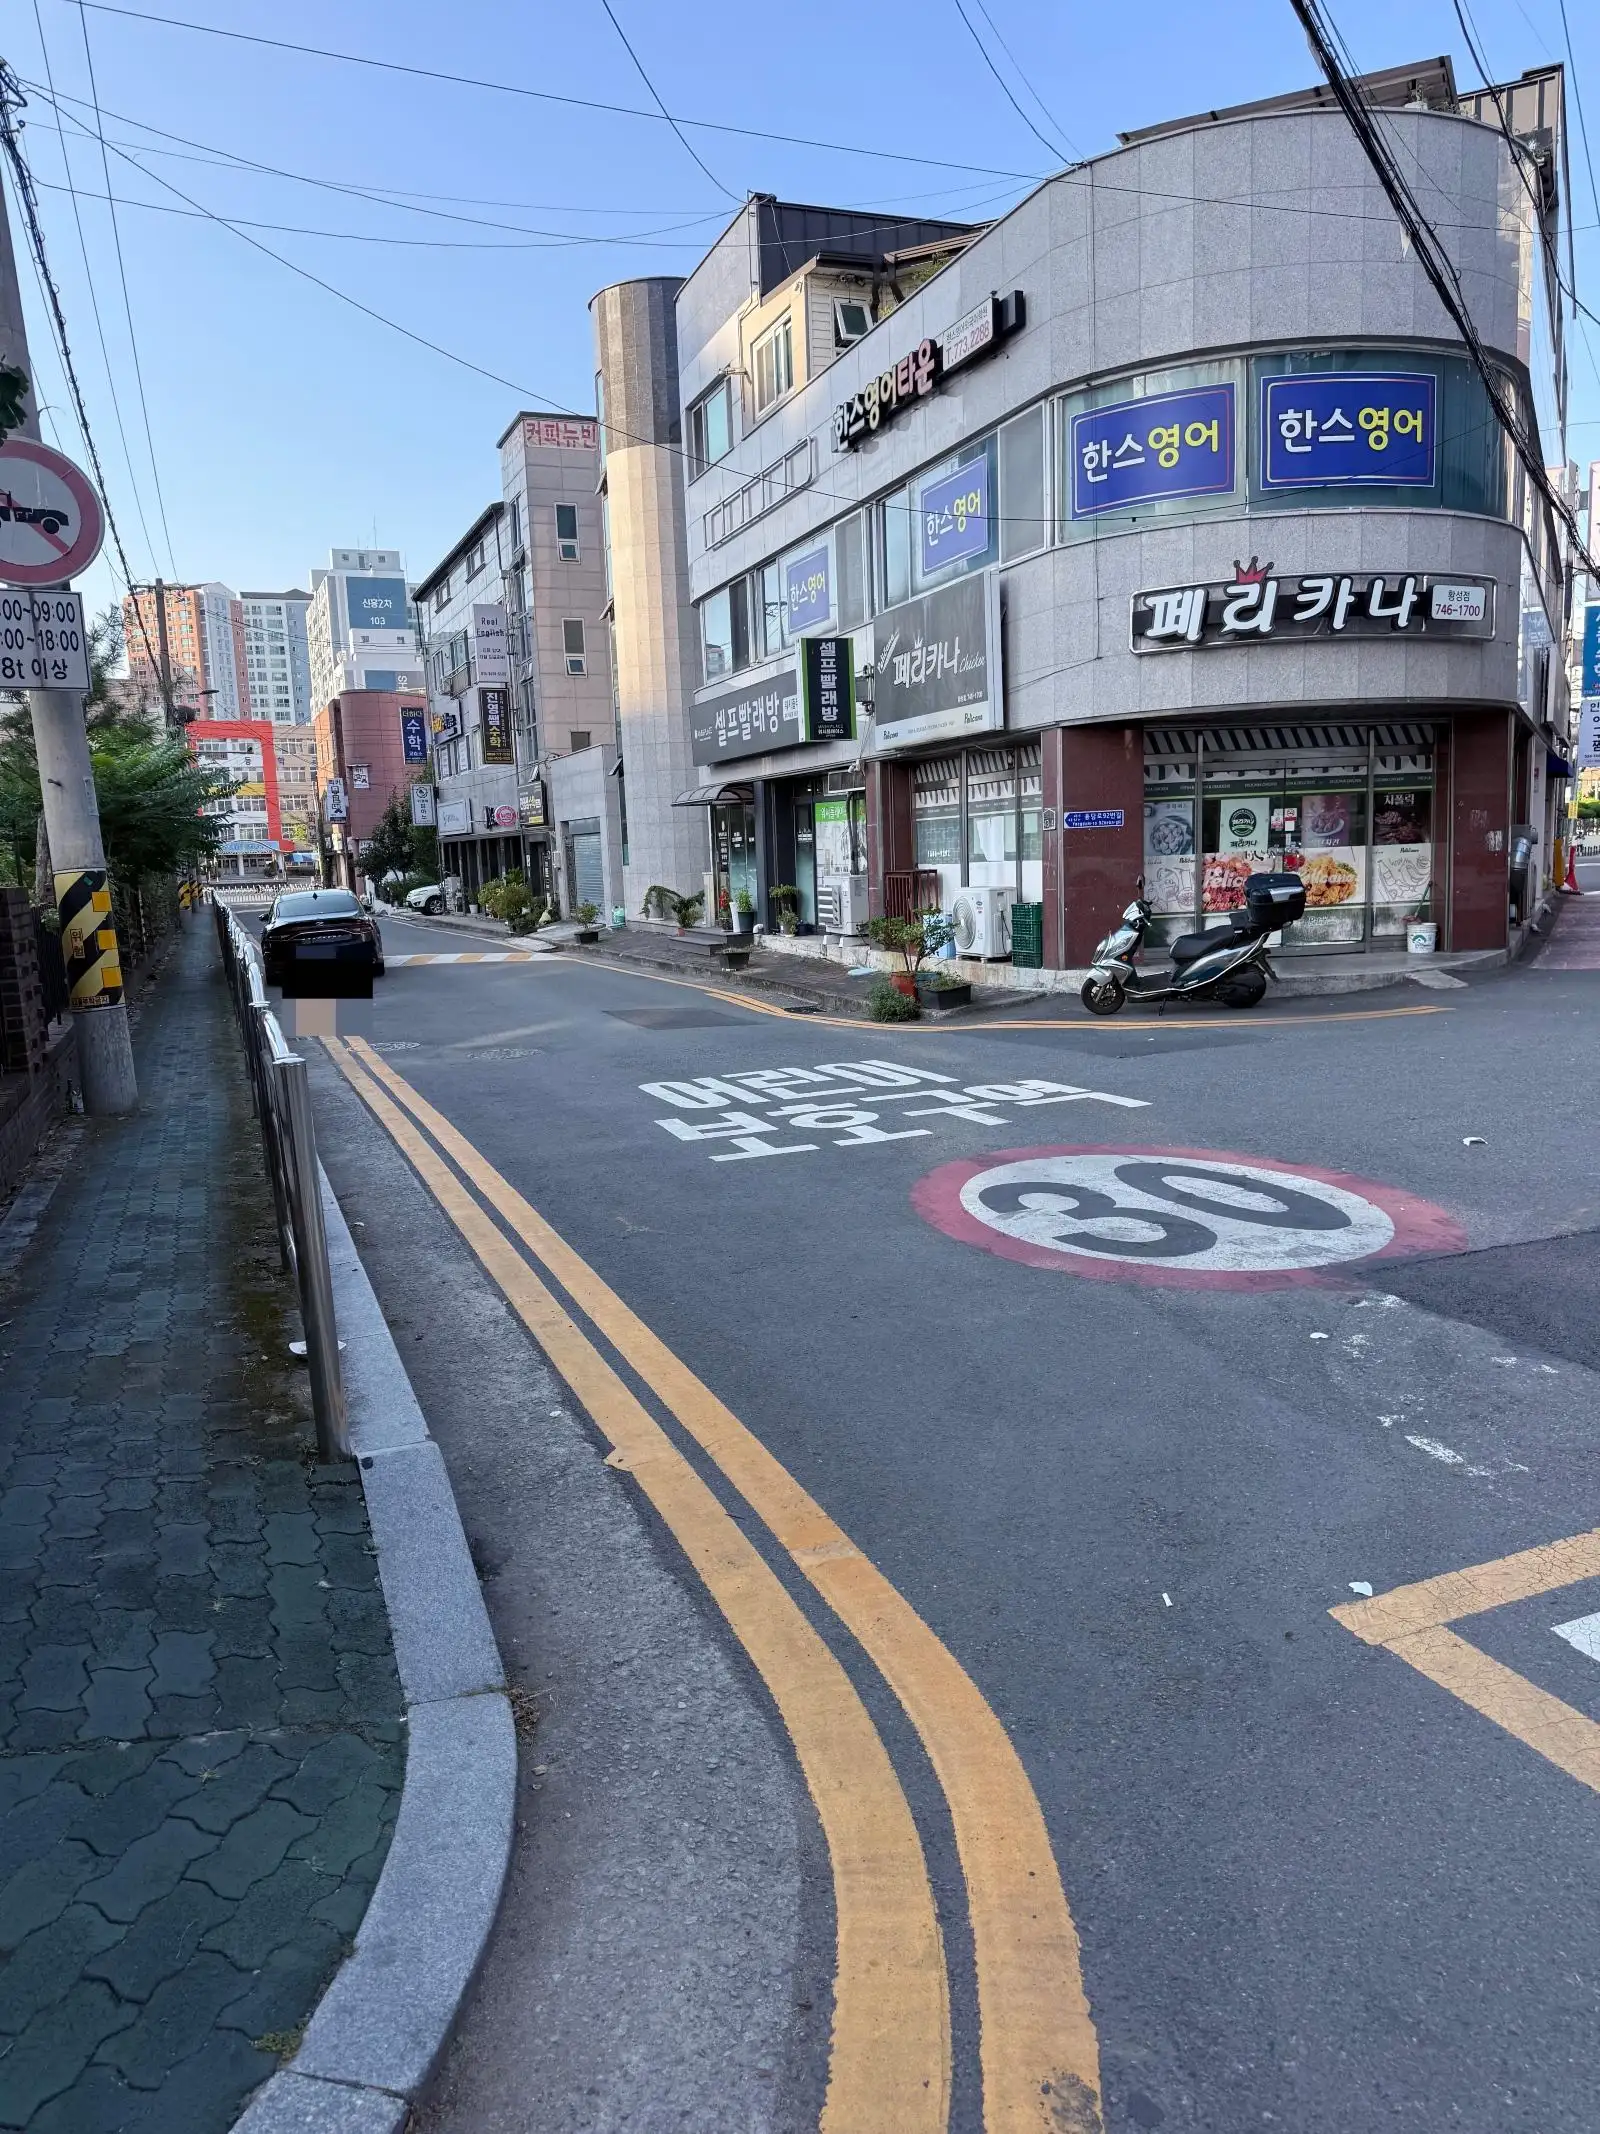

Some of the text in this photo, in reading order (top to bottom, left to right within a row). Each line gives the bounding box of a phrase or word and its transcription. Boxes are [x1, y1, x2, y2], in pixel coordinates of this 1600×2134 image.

[833, 338, 935, 449] 한스영어타운
[1081, 419, 1219, 483] 한스영어
[1279, 406, 1423, 454] 한스영어
[926, 487, 981, 547] 한스영어
[0, 599, 76, 623] 00~09:00
[789, 570, 826, 611] 한스영어
[1144, 576, 1418, 642] 페리카나
[1435, 603, 1481, 617] 746-1700
[1448, 590, 1470, 602] 황성점
[370, 616, 386, 625] 103
[31, 658, 68, 680] 이상
[820, 641, 839, 722] 셀프빨래방
[892, 636, 961, 689] 페리카나
[406, 719, 422, 751] 수학
[489, 726, 502, 748] 수학
[715, 691, 779, 747] 셀프빨래방
[638, 1059, 961, 1109] 어린이
[653, 1079, 1154, 1163] 보호구역
[977, 1162, 1353, 1258] 30
